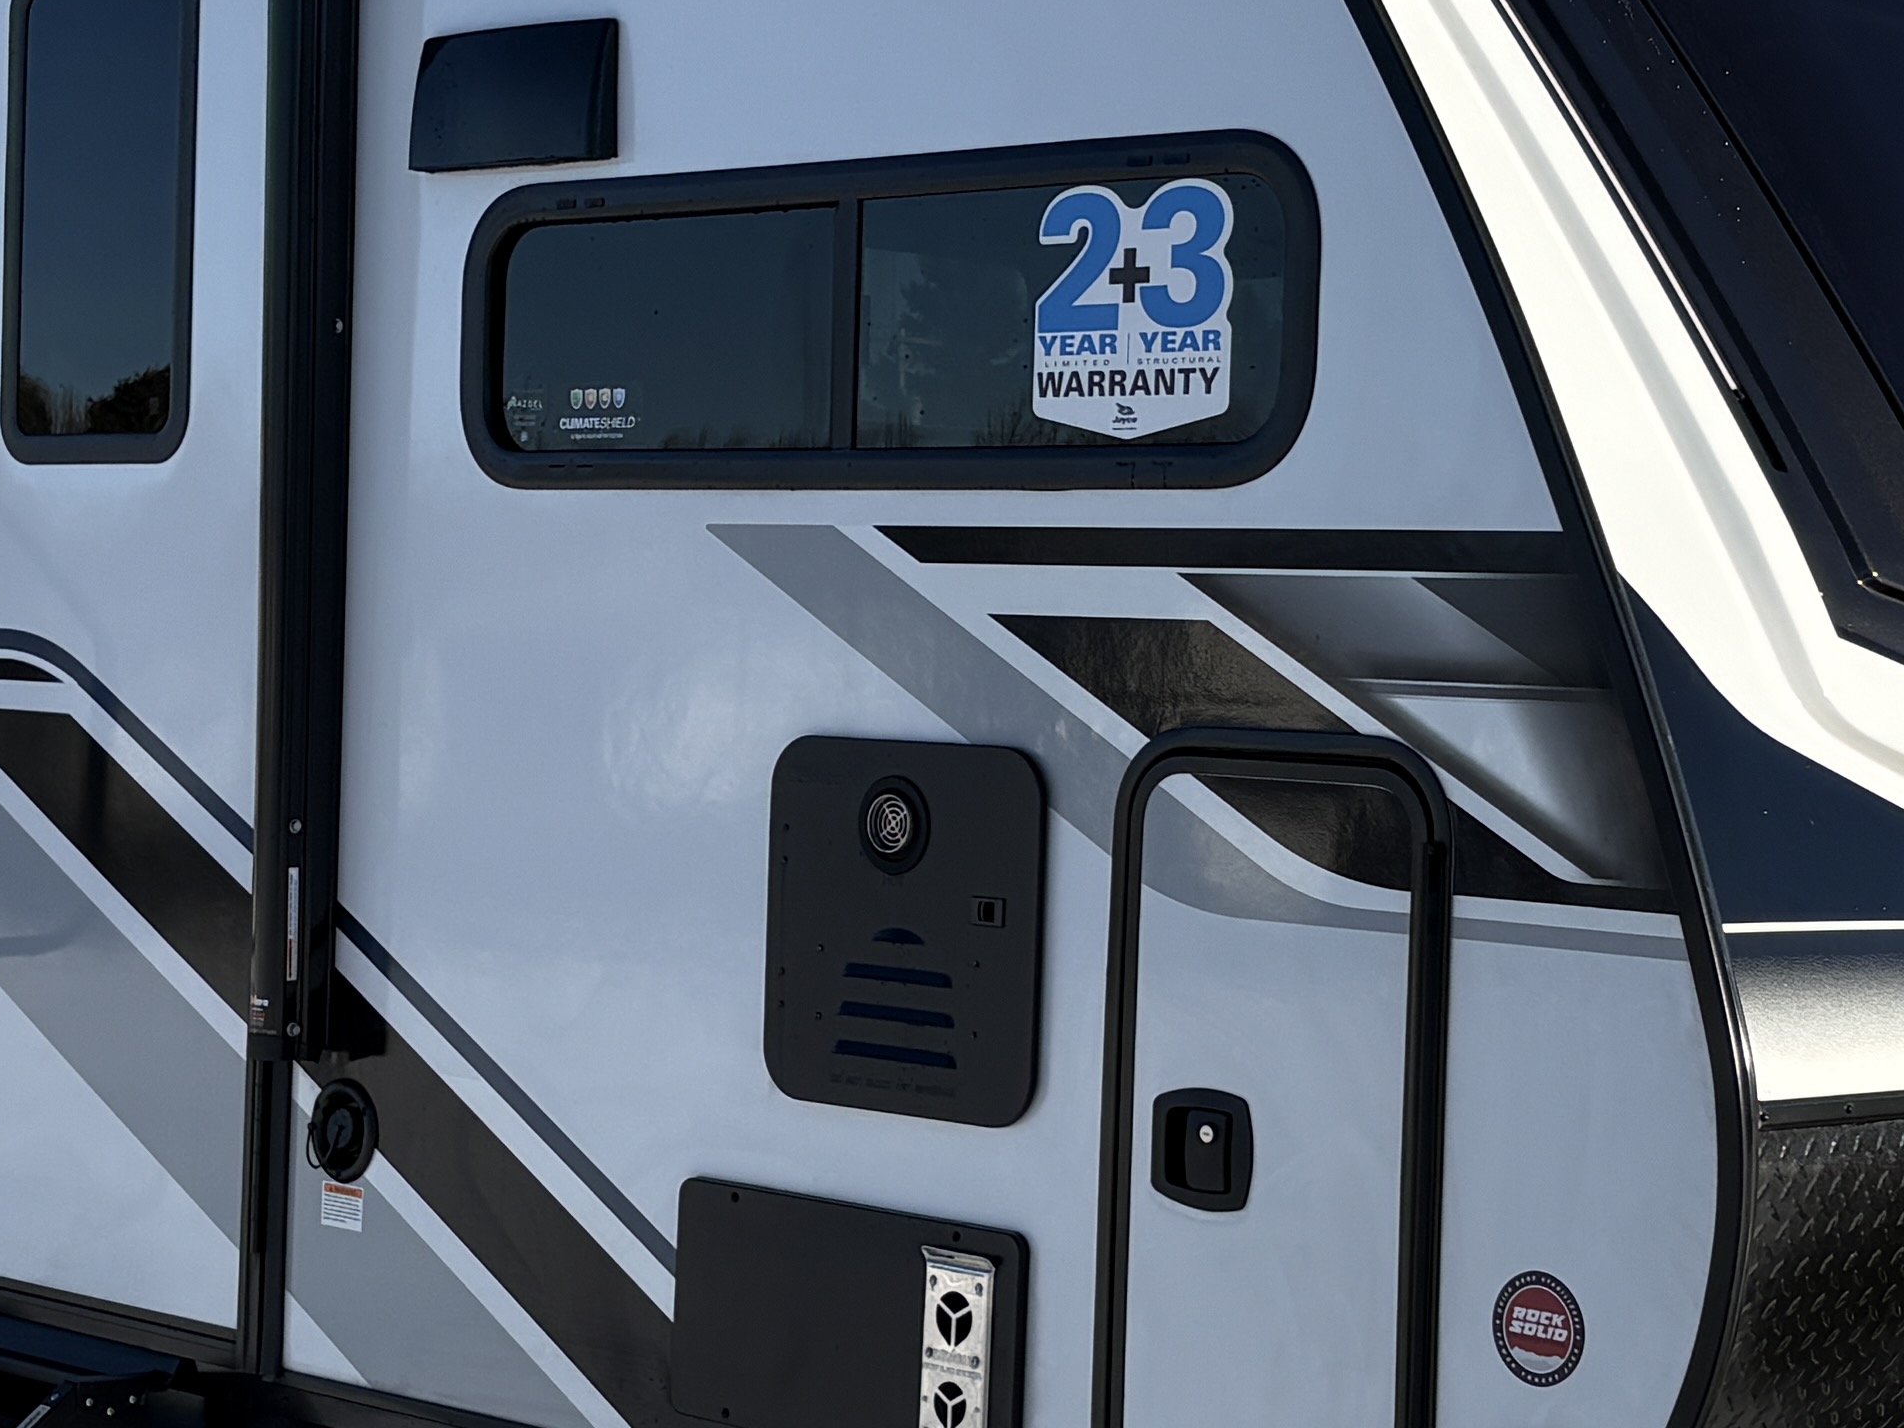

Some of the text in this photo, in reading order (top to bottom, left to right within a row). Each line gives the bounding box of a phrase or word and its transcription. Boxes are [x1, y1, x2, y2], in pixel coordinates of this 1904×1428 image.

[1038, 329, 1222, 357] YEAR YEAR
[1044, 356, 1223, 368] LIMITED STRUCTURAL
[1037, 366, 1221, 399] WARRANTY
[1512, 1306, 1566, 1328] ROCK
[1509, 1320, 1569, 1342] SOLID
